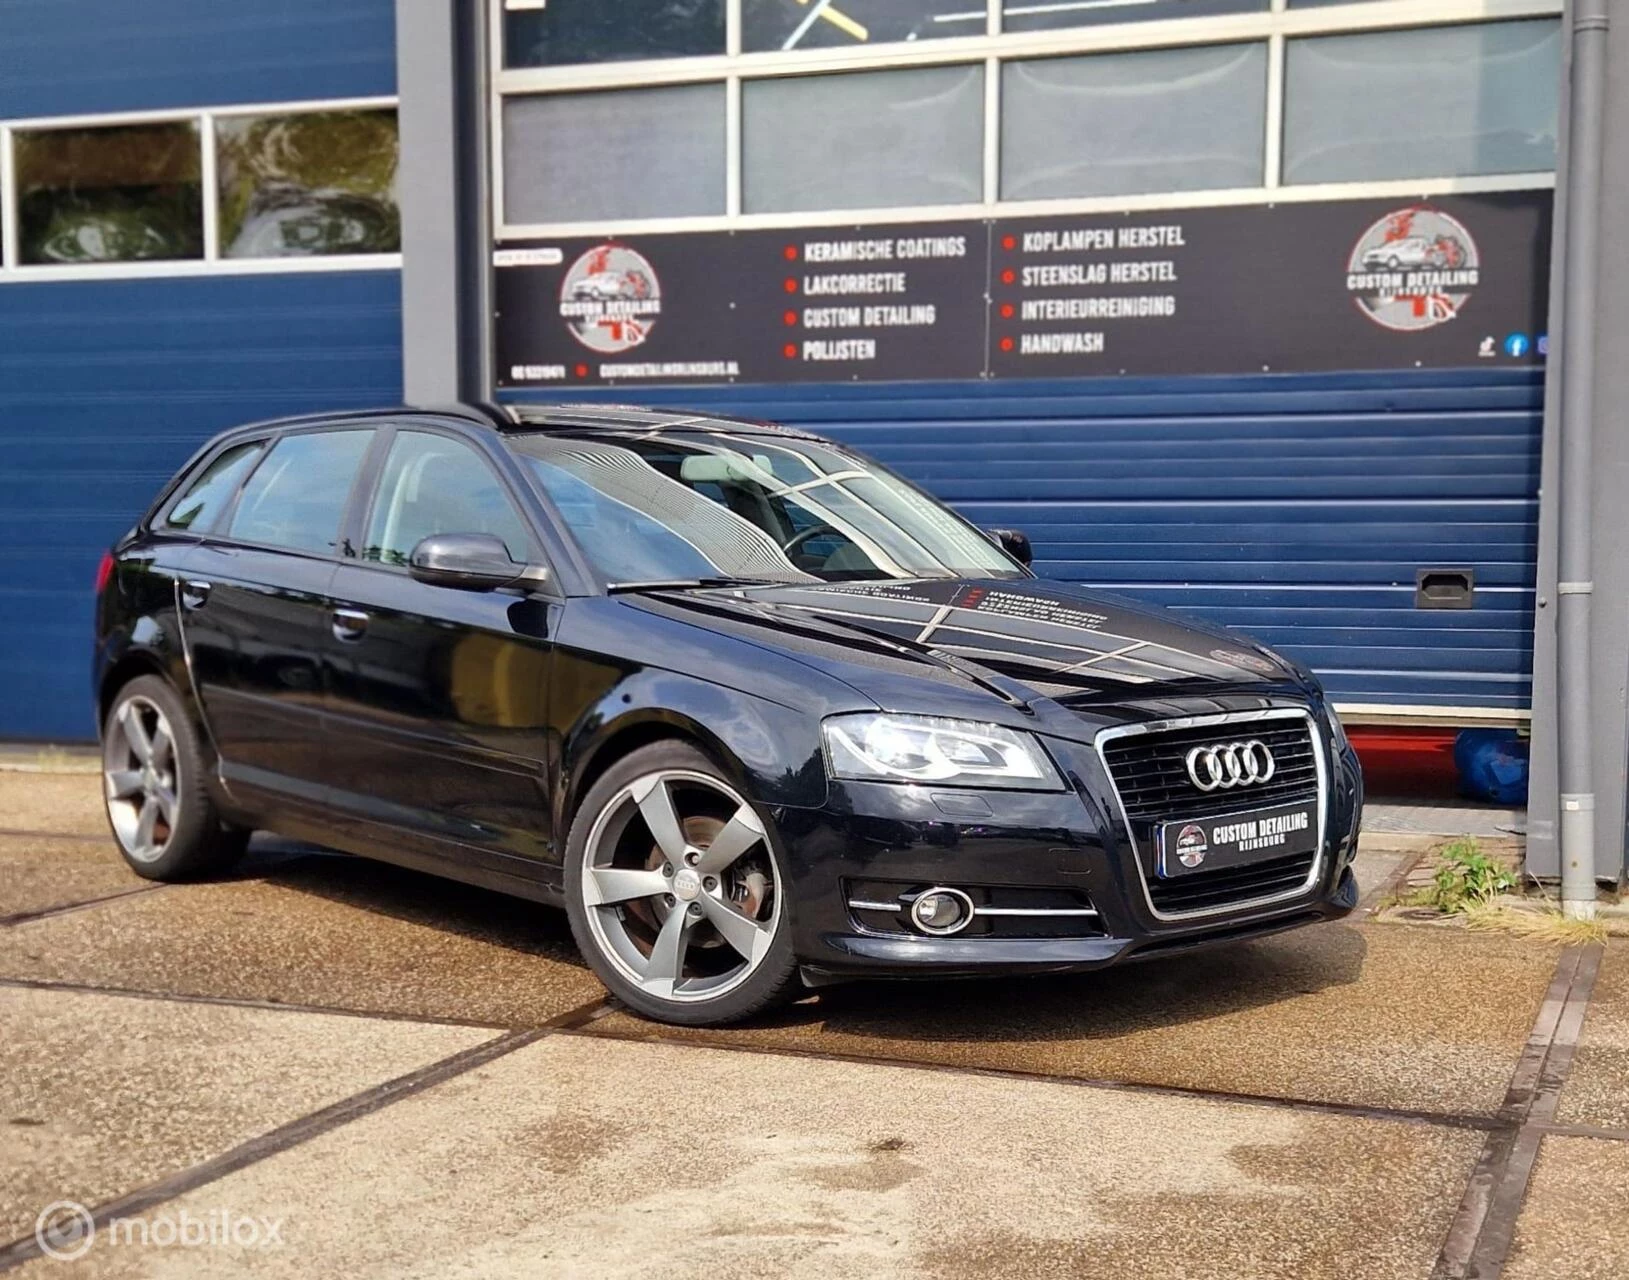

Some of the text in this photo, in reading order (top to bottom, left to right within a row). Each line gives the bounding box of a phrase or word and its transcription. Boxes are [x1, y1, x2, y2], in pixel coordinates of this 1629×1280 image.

[804, 236, 966, 262] KERAMISCHE COATINGS
[1023, 226, 1186, 252] KOPLAMPEN HERSTEL
[803, 272, 906, 295] LAKCORRECTIE
[1022, 261, 1177, 287] STEENSLAG HERSTEL
[1347, 270, 1479, 290] CUSTOM DETAILING
[803, 304, 936, 328] CUSTOM DETAILING
[1021, 296, 1176, 320] INTERIEURREINIGING
[803, 339, 876, 361] POLIJSTEN
[1021, 332, 1104, 354] HANDWASH
[1213, 812, 1308, 845] CUSTOM DETAILING
[1239, 834, 1286, 852] RIJNSBURG
